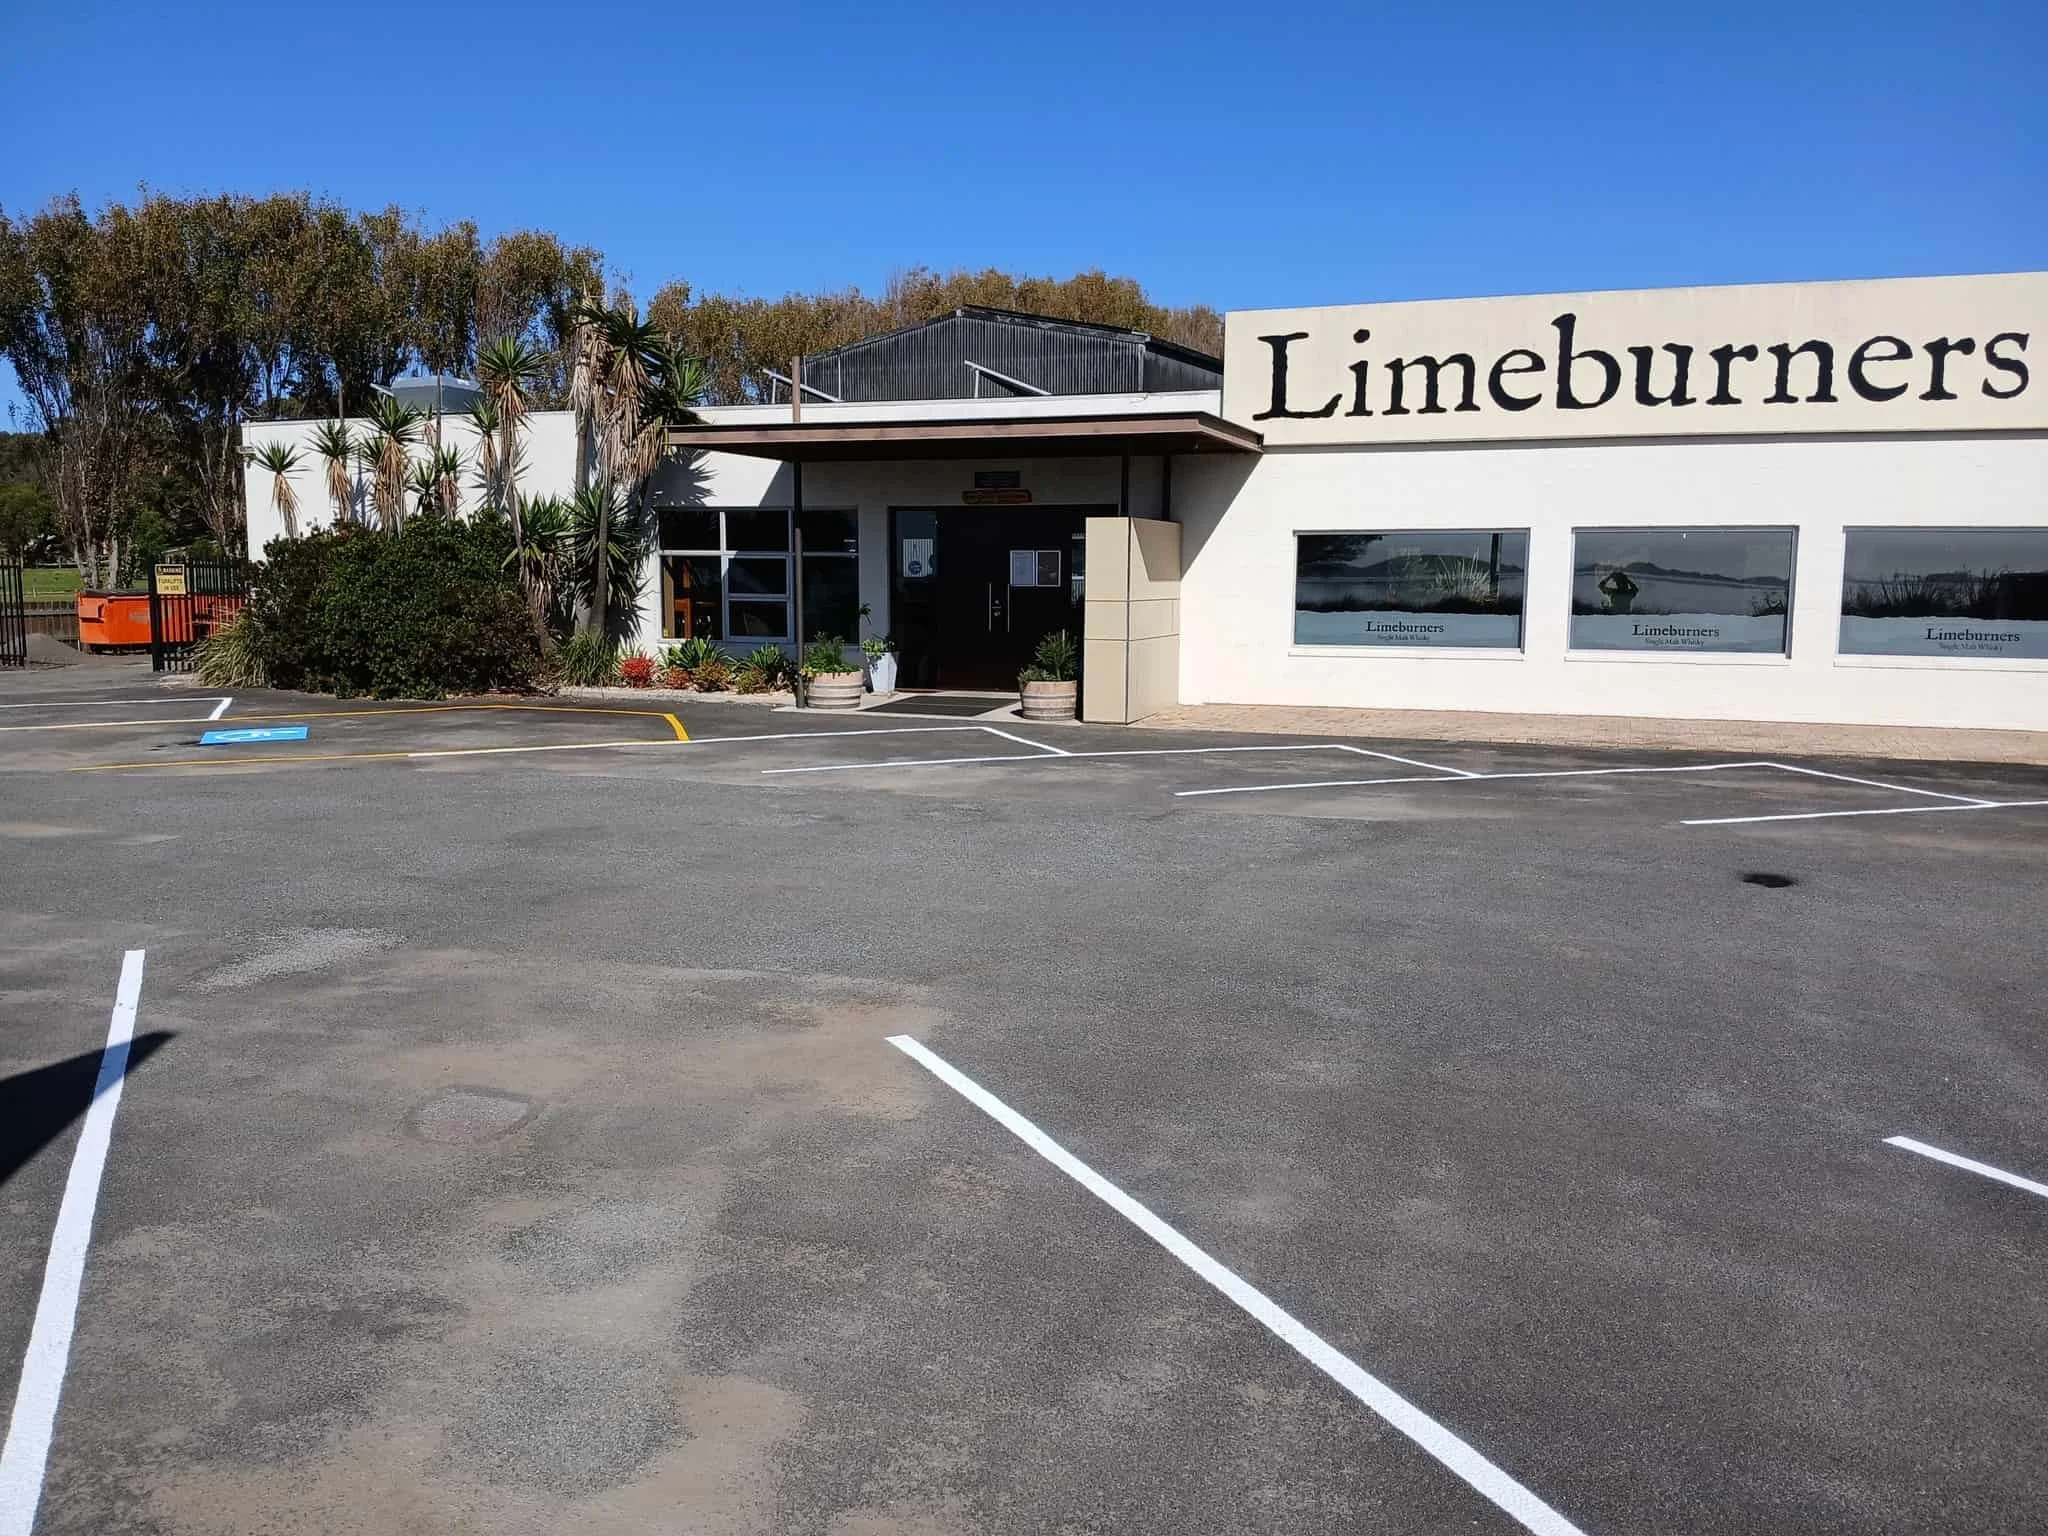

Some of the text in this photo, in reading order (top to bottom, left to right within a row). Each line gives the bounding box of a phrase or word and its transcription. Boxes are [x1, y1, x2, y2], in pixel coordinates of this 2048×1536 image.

[1253, 314, 2030, 420] Limeburners
[1366, 621, 1445, 632] Limeburners
[1632, 624, 1719, 637] Limeburners
[1926, 628, 2020, 642] Limeburners
